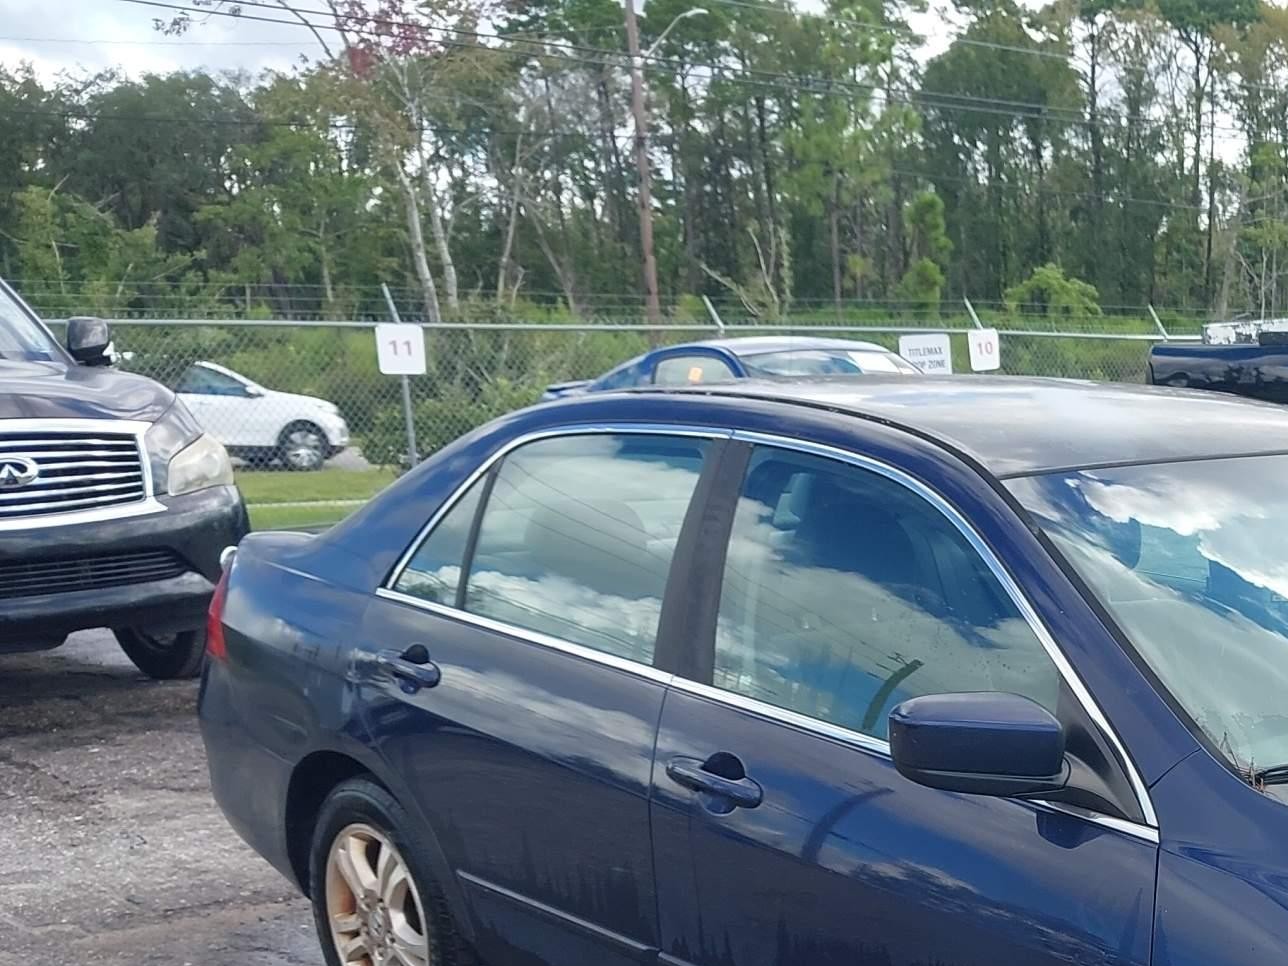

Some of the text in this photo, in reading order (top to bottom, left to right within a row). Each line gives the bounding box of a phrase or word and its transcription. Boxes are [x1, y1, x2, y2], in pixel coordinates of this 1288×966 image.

[388, 339, 413, 357] 11
[908, 346, 944, 357] TITLEMAX
[977, 340, 994, 356] 10
[928, 359, 946, 369] ZONE
